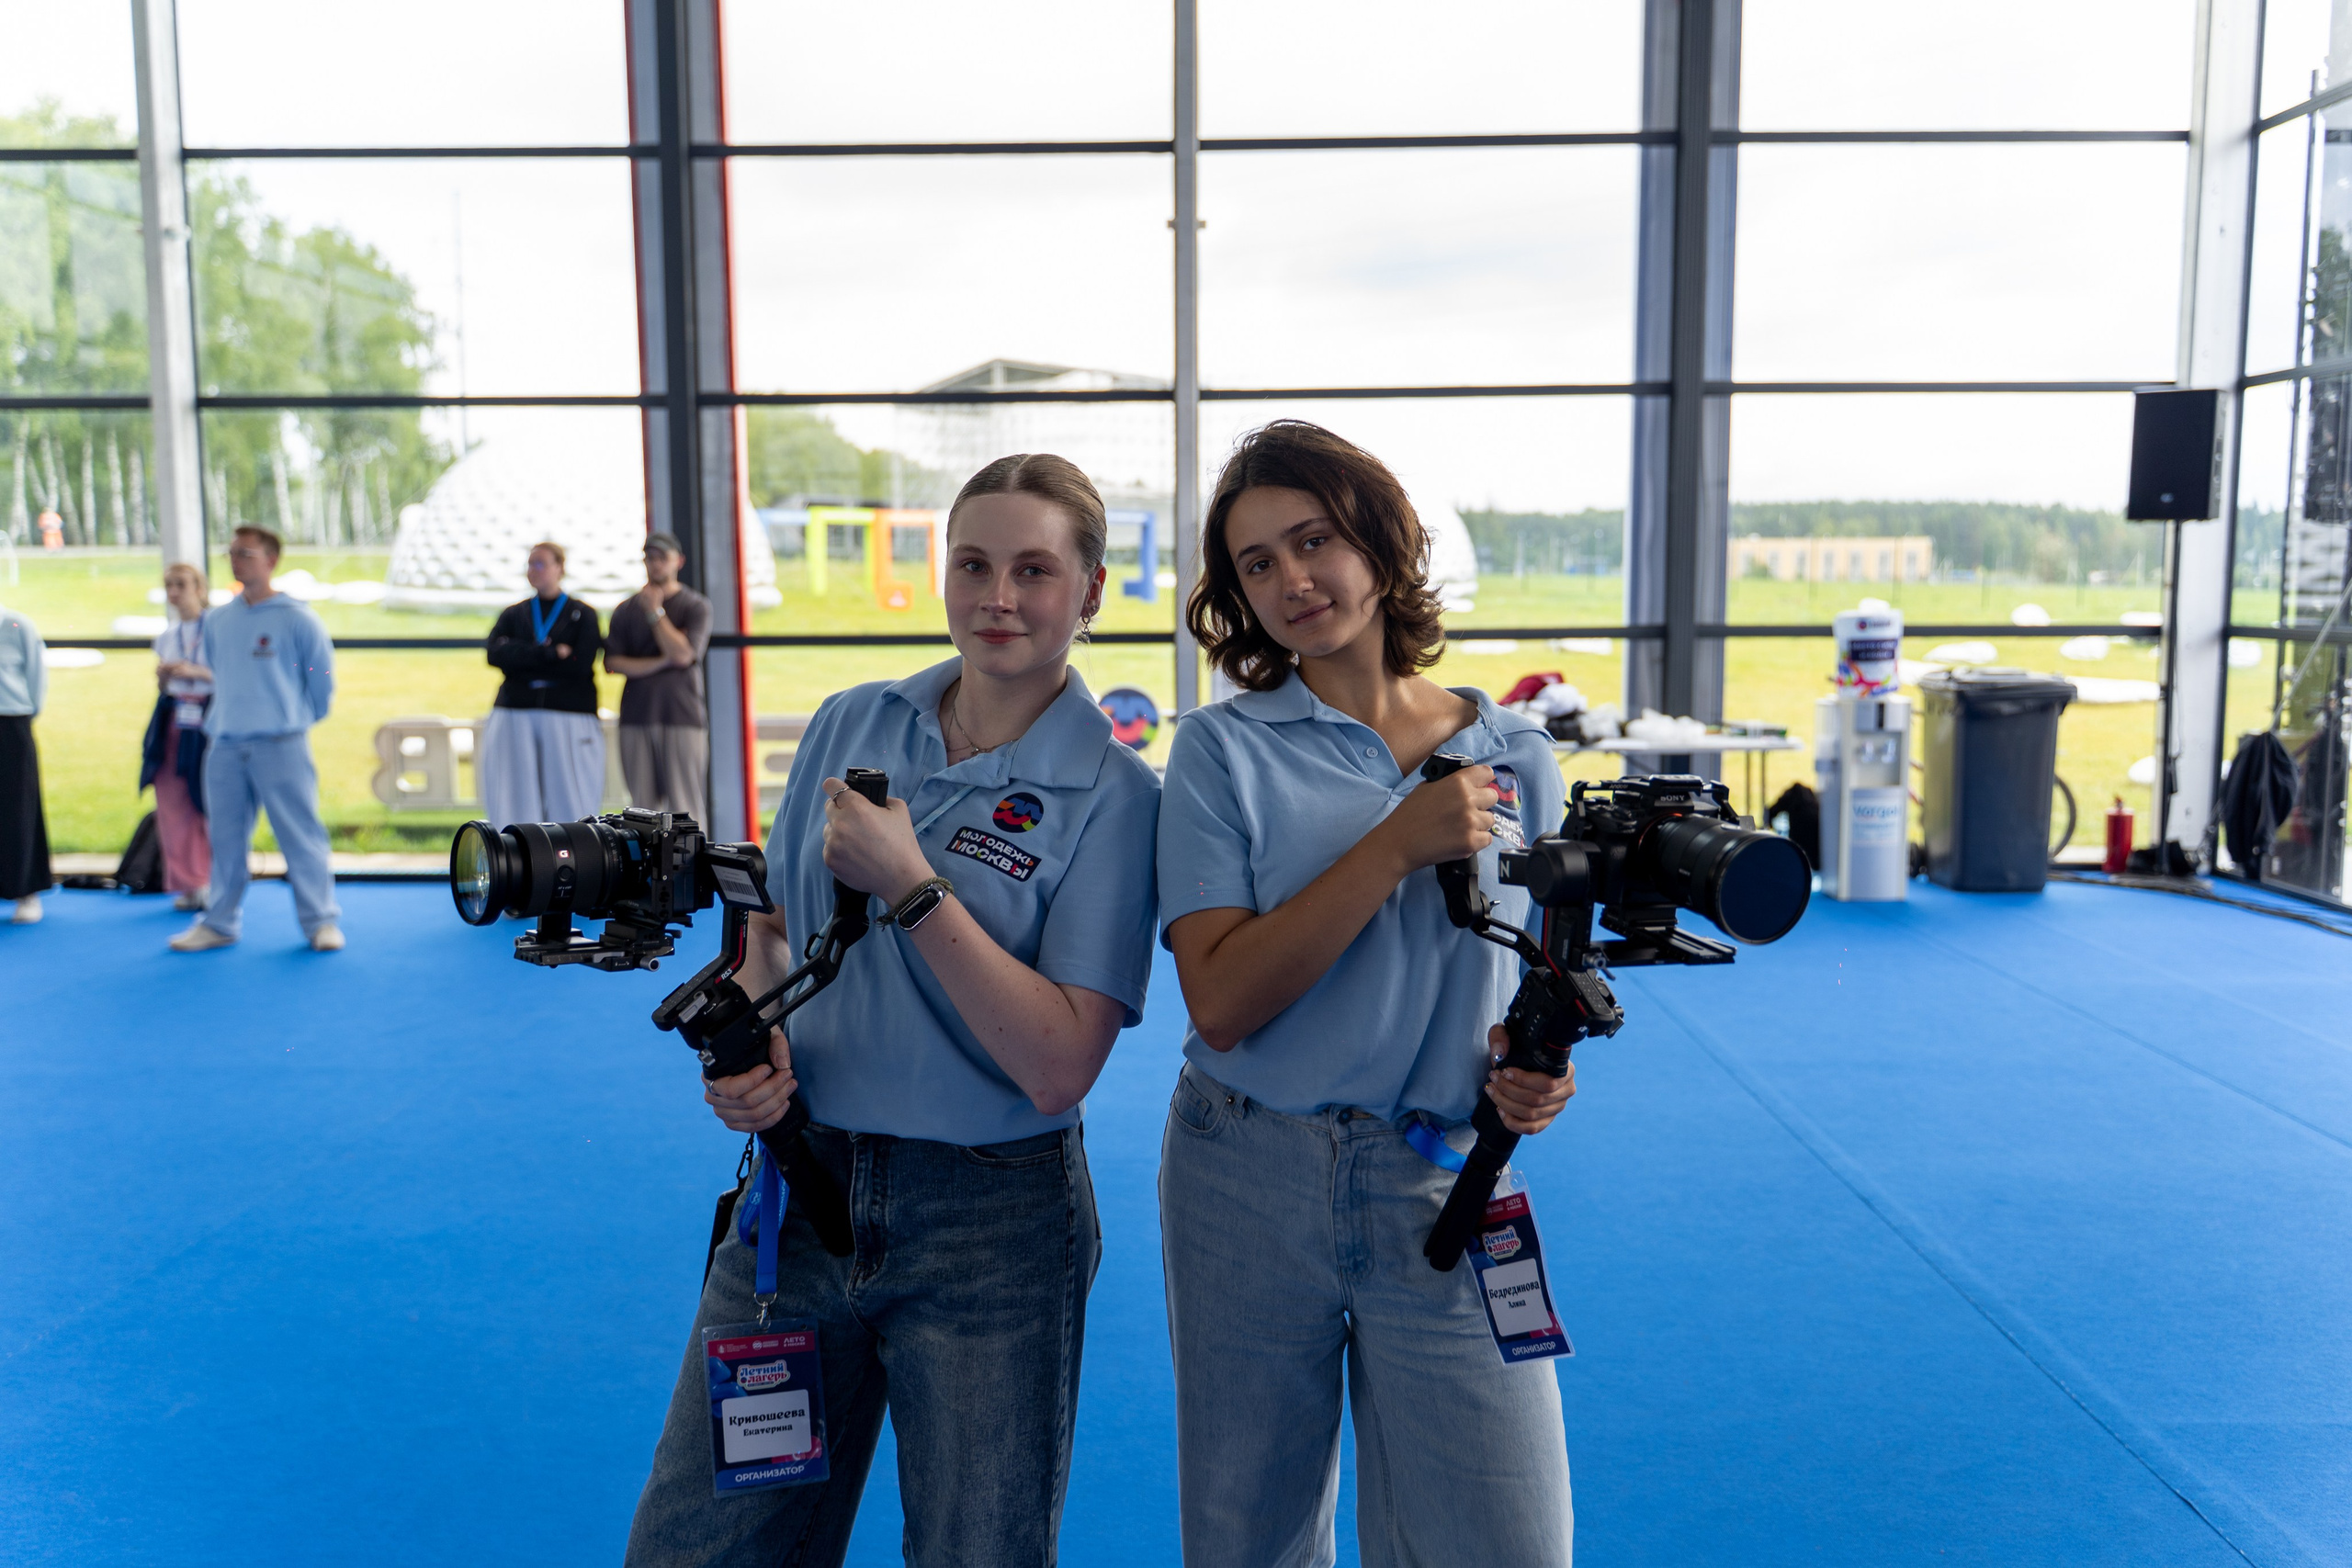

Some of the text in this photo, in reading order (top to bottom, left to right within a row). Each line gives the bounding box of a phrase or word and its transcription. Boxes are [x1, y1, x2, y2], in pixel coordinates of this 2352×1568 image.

[951, 840, 1029, 879] МОСКВЫ
[1485, 1230, 1515, 1246] Летний
[1491, 1239, 1520, 1253] лагерь
[1488, 1280, 1540, 1299] Бедрединова
[1508, 1300, 1527, 1309] Алина
[1511, 1341, 1556, 1356] ОРГАНИЗАТОР
[740, 1362, 785, 1377] Летний
[747, 1371, 788, 1383] лагерь
[729, 1408, 806, 1427] Кривошеева
[743, 1425, 793, 1437] Екатерина
[735, 1465, 805, 1483] ОРГАНИЗАТОР
